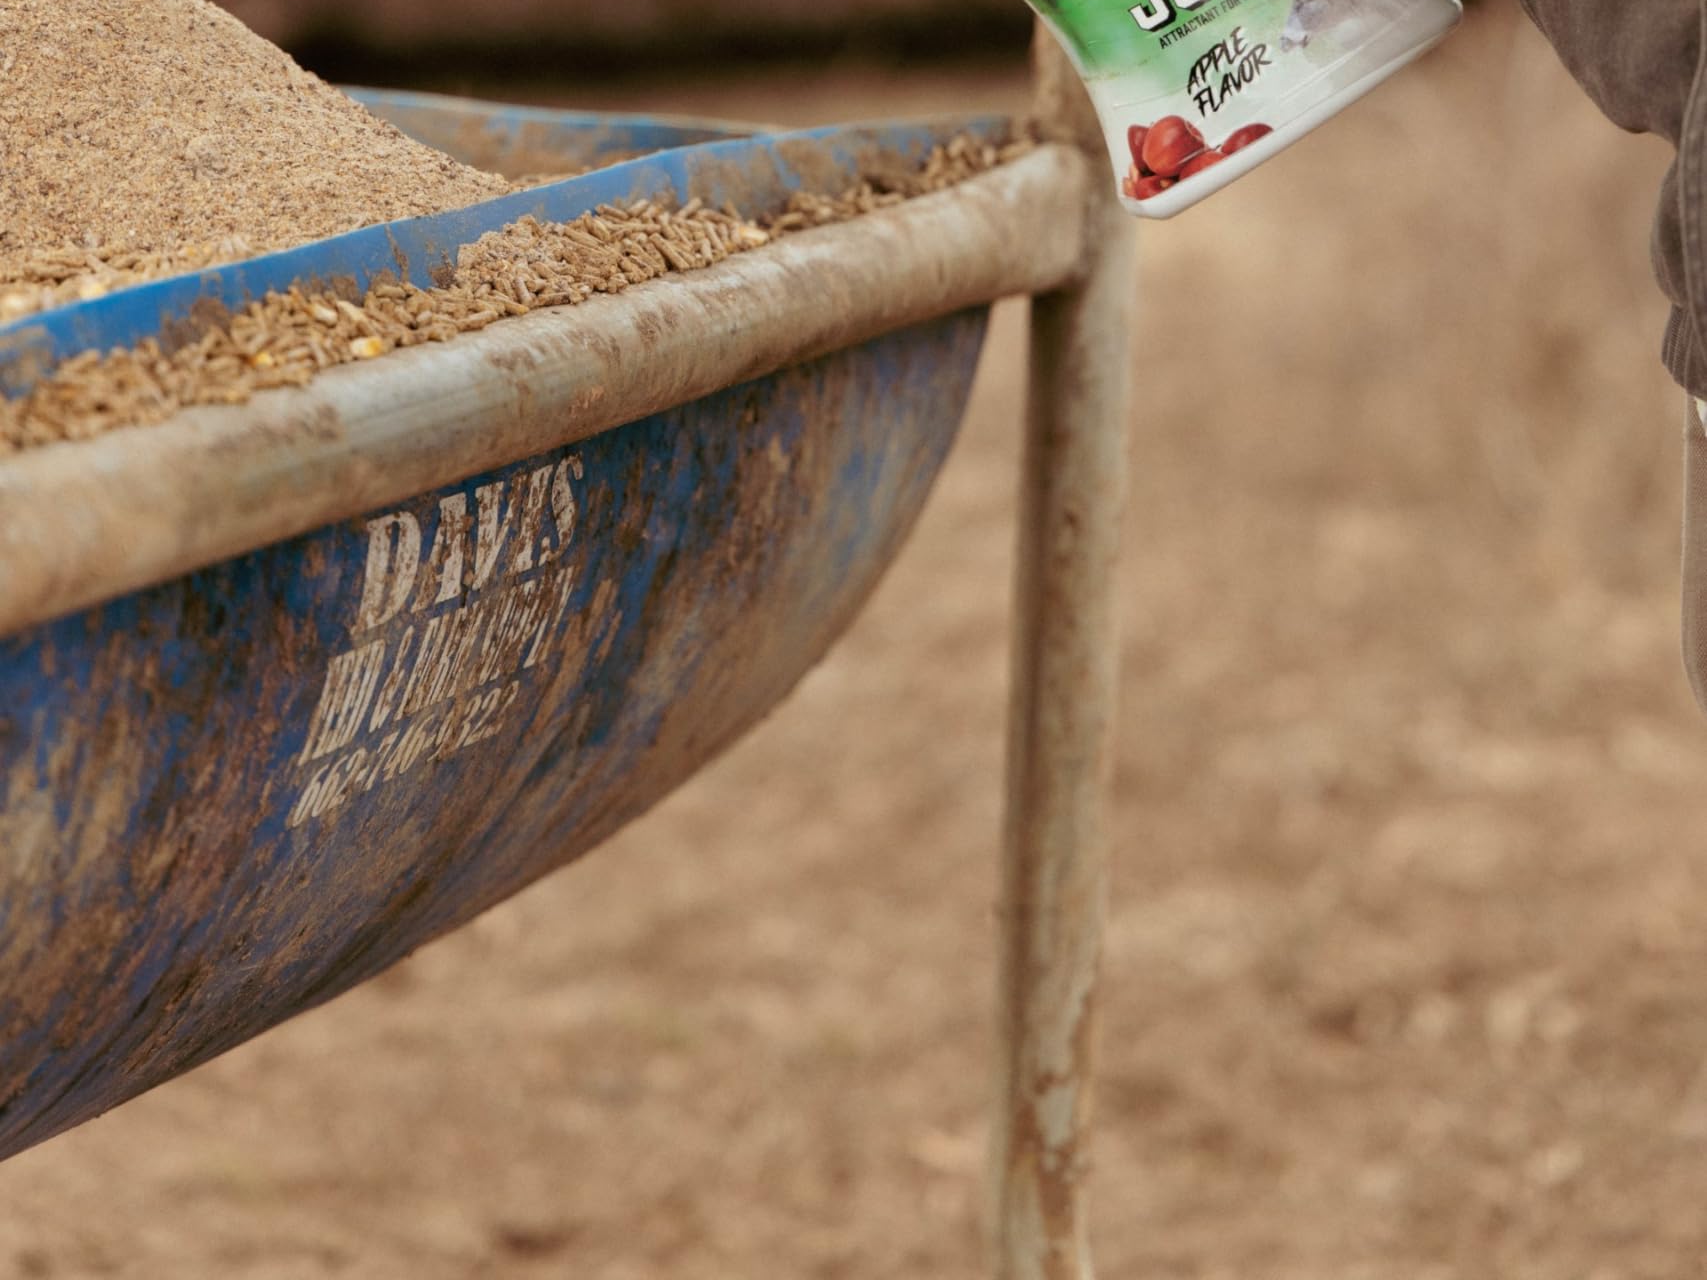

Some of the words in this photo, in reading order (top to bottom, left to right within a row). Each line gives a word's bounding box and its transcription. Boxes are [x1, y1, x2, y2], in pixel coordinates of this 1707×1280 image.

[1158, 6, 1222, 50] ATTRACTANT
[1186, 25, 1249, 97] APPLE
[1192, 43, 1273, 118] FLAVOR
[350, 452, 585, 637] DAVIS
